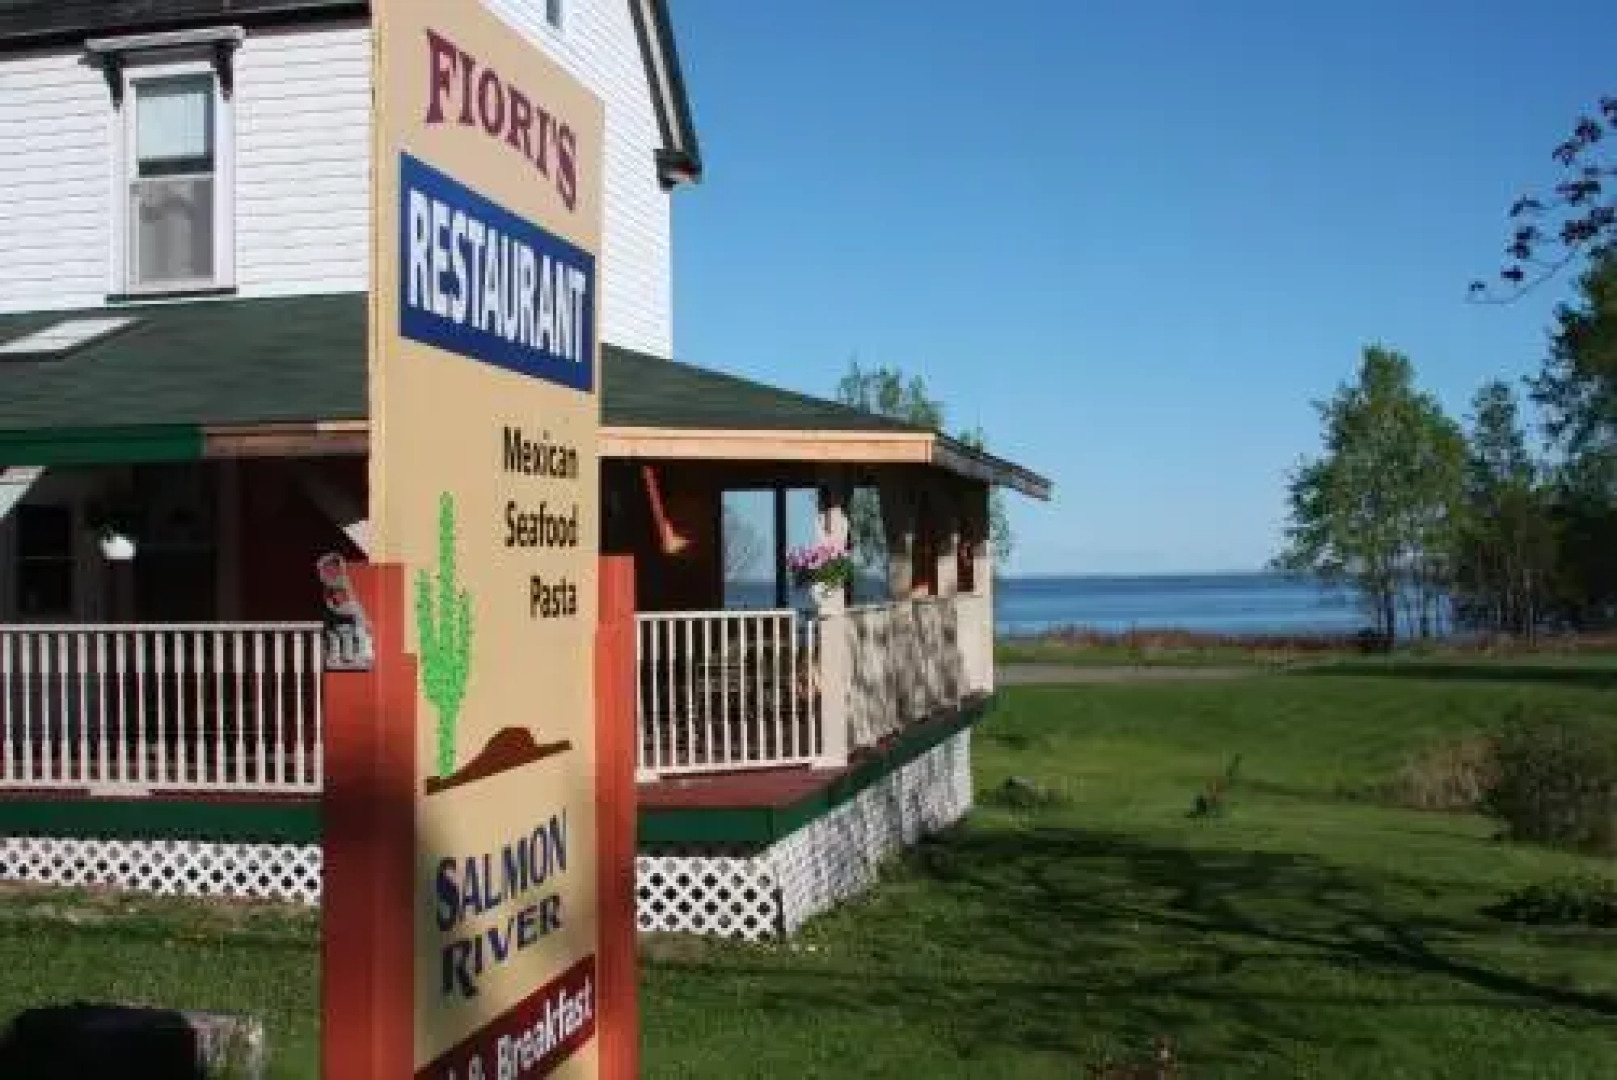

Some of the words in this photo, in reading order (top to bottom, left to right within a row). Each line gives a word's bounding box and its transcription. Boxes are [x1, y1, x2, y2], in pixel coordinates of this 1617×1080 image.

[426, 28, 578, 213] FIORI'S
[407, 189, 587, 364] RESTAURANT
[503, 426, 578, 479] Mexican
[504, 501, 578, 548] Seafood
[530, 575, 577, 619] Pasta
[435, 806, 567, 932] SALMON
[440, 894, 562, 999] RIVER
[497, 975, 592, 1080] Breakfast
